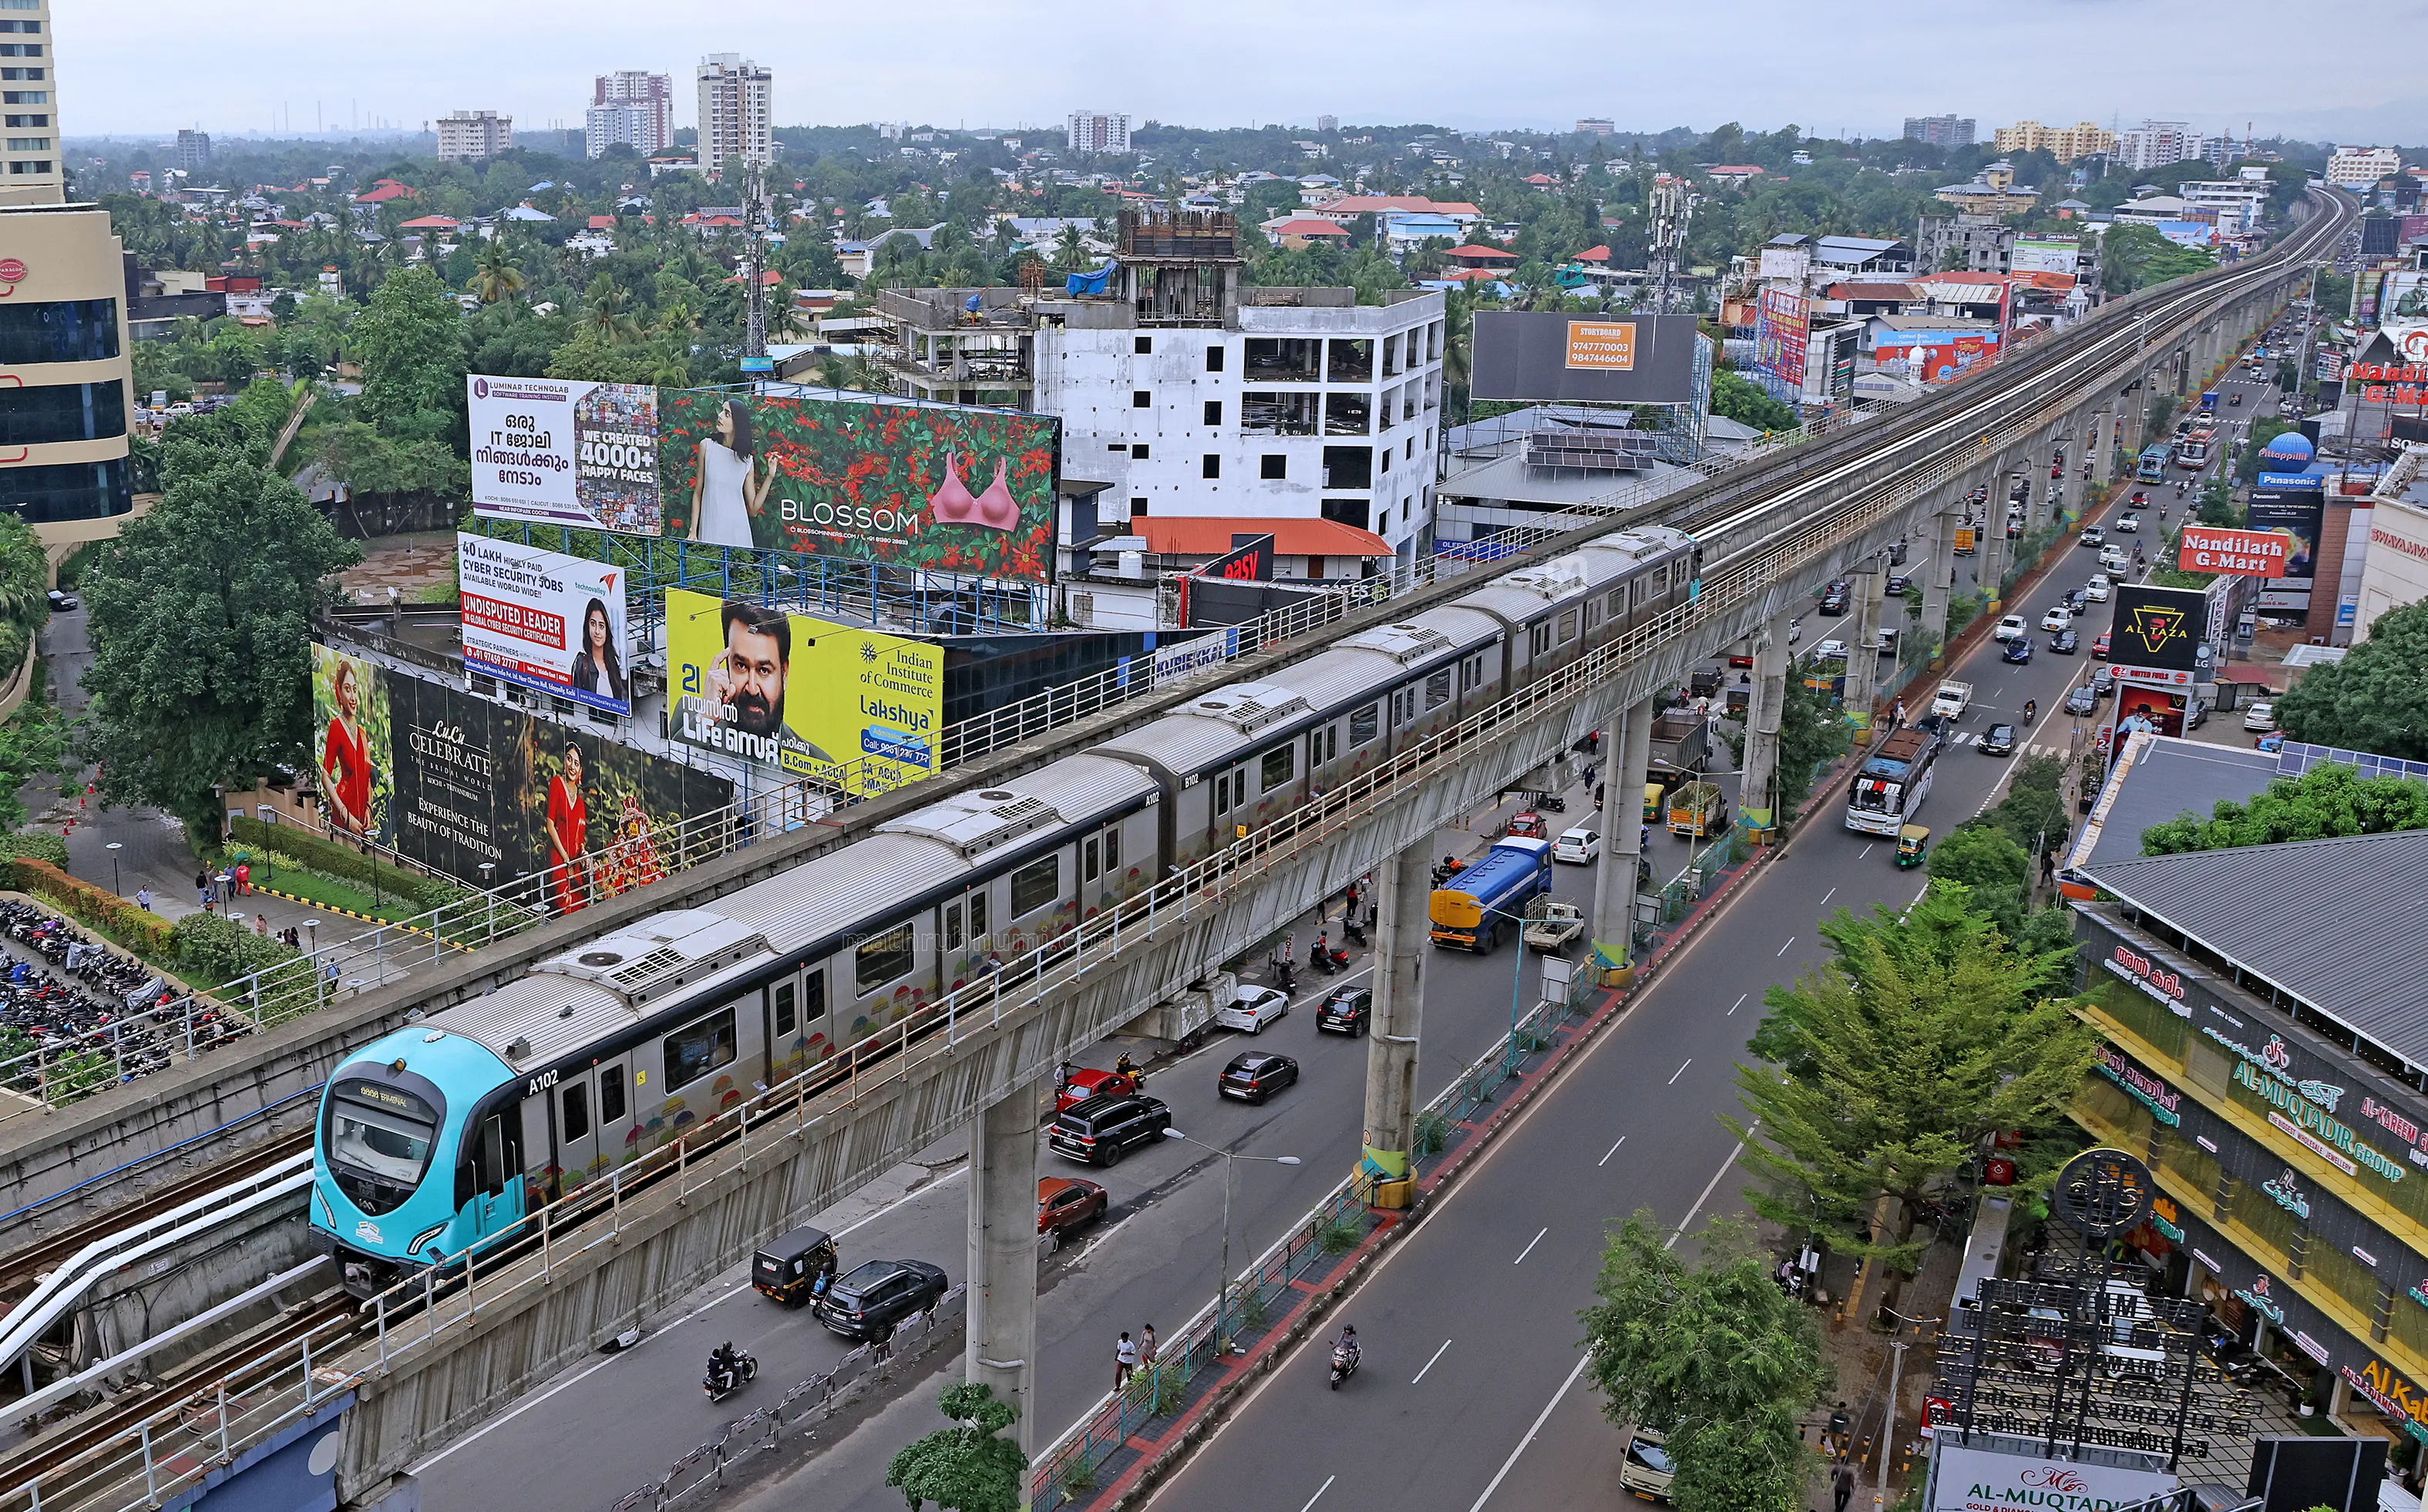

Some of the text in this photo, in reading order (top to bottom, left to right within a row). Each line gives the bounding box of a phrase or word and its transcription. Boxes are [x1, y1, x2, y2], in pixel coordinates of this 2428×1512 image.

[1580, 328, 1622, 337] STORYBOARD
[1572, 341, 1629, 352] 9747770003
[1572, 352, 1628, 363] 9847446604
[489, 381, 570, 394] LUMINAR TECHNOLAB
[493, 391, 518, 399] SOFTWARE
[506, 414, 535, 433] ഒരു
[491, 431, 552, 449] IT ജോലി
[582, 429, 651, 448] WE CREATED
[580, 442, 654, 470] 4000+
[2258, 447, 2309, 461] Pittappillil
[498, 469, 542, 486] നേടാം
[581, 465, 654, 485] HAPPY FACES
[2263, 475, 2316, 486] Panasonic
[513, 507, 532, 516] INFOPARK
[532, 509, 550, 517] COCHIN
[781, 499, 919, 535] BLOSSOM
[796, 527, 857, 540] BLOSSOMINNERS.COM
[2184, 533, 2283, 557] Nandilath
[462, 541, 476, 557] 40
[478, 547, 502, 563] LAKH
[527, 561, 543, 573] PAID
[1224, 549, 1259, 580] easy
[463, 559, 564, 593] CYBER SECURITY JOBS
[463, 573, 496, 589] AVAILABLE
[497, 580, 520, 594] WORLD
[575, 580, 607, 596] technovalley
[463, 594, 561, 636] UNDISPUTED LEADER
[2242, 605, 2256, 613] LG
[465, 613, 561, 647] IN GLOBAL CYBER SECURITY CERTIFICATIONS
[2124, 624, 2188, 639] AL TAZA
[466, 636, 493, 650] STRATEGIC
[493, 642, 520, 657] PARTNERS
[473, 649, 484, 660] +91
[484, 650, 501, 667] 97459
[501, 657, 520, 670] 27777
[896, 650, 933, 670] Indian
[2194, 658, 2209, 668] LG
[464, 658, 484, 671] Technovalley
[483, 664, 497, 674] Software
[497, 668, 506, 677] India
[527, 677, 540, 687] Oberon
[681, 663, 701, 694] 21
[886, 662, 933, 684] Institute
[2130, 670, 2151, 678] UNITED
[860, 670, 933, 698] of Commerce
[860, 694, 930, 731] Lakshya
[432, 720, 466, 745] LuLu
[873, 728, 903, 741] Admission
[409, 731, 492, 778] CELEBRATE
[863, 737, 880, 751] Call:
[410, 754, 492, 792] THE BRIDAL WORLD
[784, 752, 812, 771] B.Com
[813, 764, 820, 774] +
[427, 776, 479, 802] KOCHI TRIVANDRUM
[418, 796, 489, 838] EXPERIENCE THE
[407, 811, 503, 861] BEAUTY OF TRADITION
[529, 1069, 560, 1096] A102
[2233, 1060, 2356, 1155] AL-MUQTADIR
[2354, 1141, 2406, 1184] GROUP
[2360, 1097, 2419, 1145] AL-KAREEM
[2268, 1113, 2353, 1173] THE BIGGEST WHOLESALE JEWELLERY
[2362, 1360, 2391, 1394] Al
[2340, 1364, 2362, 1388] GOLD
[2362, 1381, 2370, 1393] &
[2369, 1386, 2407, 1422] DIAMOND
[1966, 1501, 1992, 1512] GOLD
